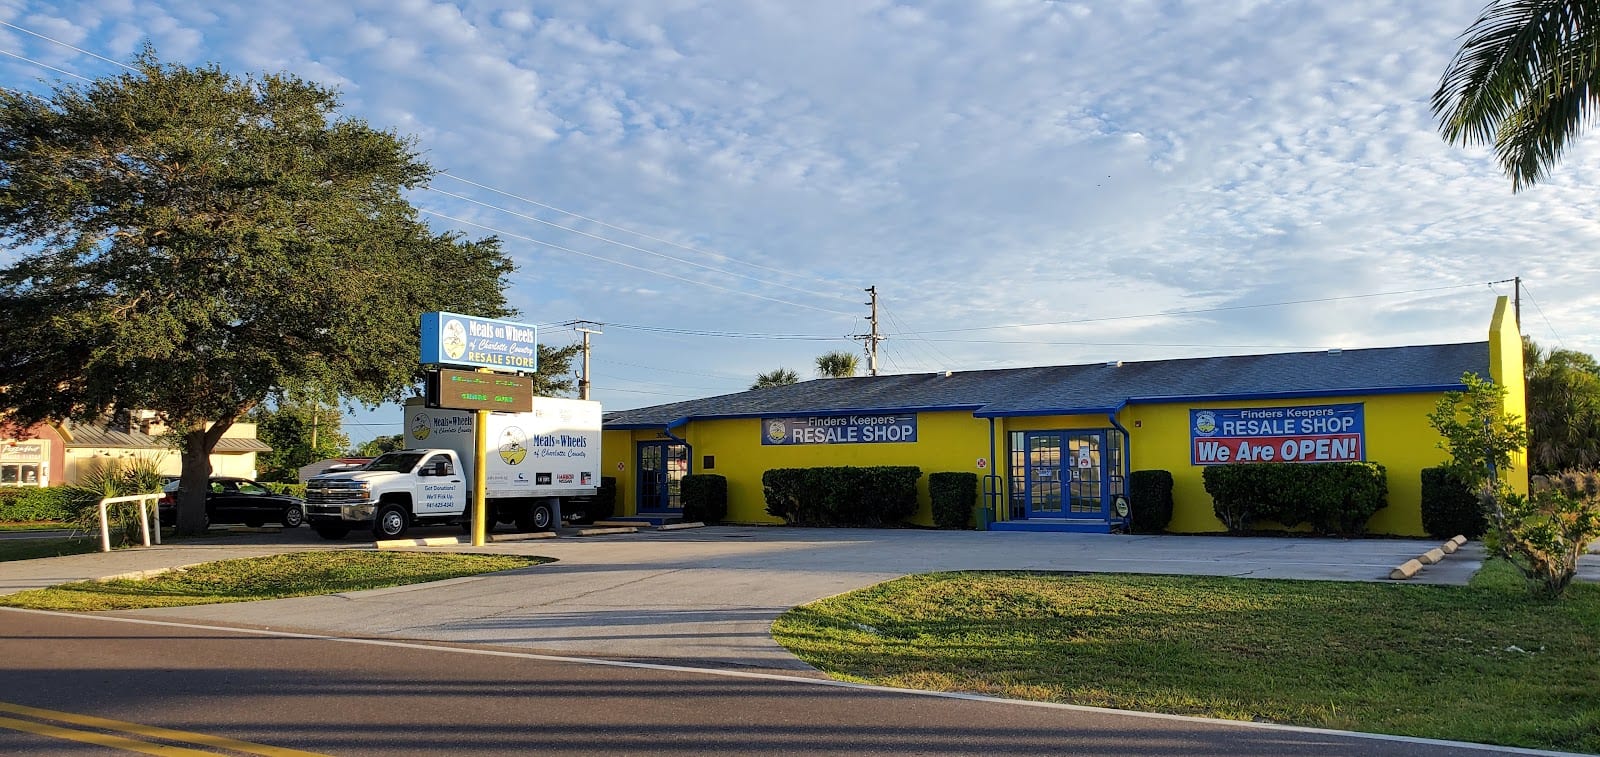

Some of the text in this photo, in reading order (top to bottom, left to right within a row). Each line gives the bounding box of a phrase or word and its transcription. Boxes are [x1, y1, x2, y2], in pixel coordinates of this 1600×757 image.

[470, 320, 534, 343] Meals on Wheels
[469, 338, 476, 350] of
[478, 338, 508, 352] Charlotte
[468, 352, 534, 367] RESALE STORE
[1241, 408, 1334, 418] Finders Keepers
[434, 418, 448, 426] Meals
[452, 416, 472, 426] Wheels
[808, 416, 895, 426] Finders Keepers
[1224, 420, 1295, 435] RESALE
[1302, 416, 1354, 432] SHOP
[534, 434, 555, 446] Meals
[560, 434, 586, 447] Wheels
[792, 427, 858, 442] RESALE
[863, 425, 913, 442] SHOP
[534, 448, 586, 459] of Charlotte County
[1198, 438, 1357, 461] We Are OPEN!
